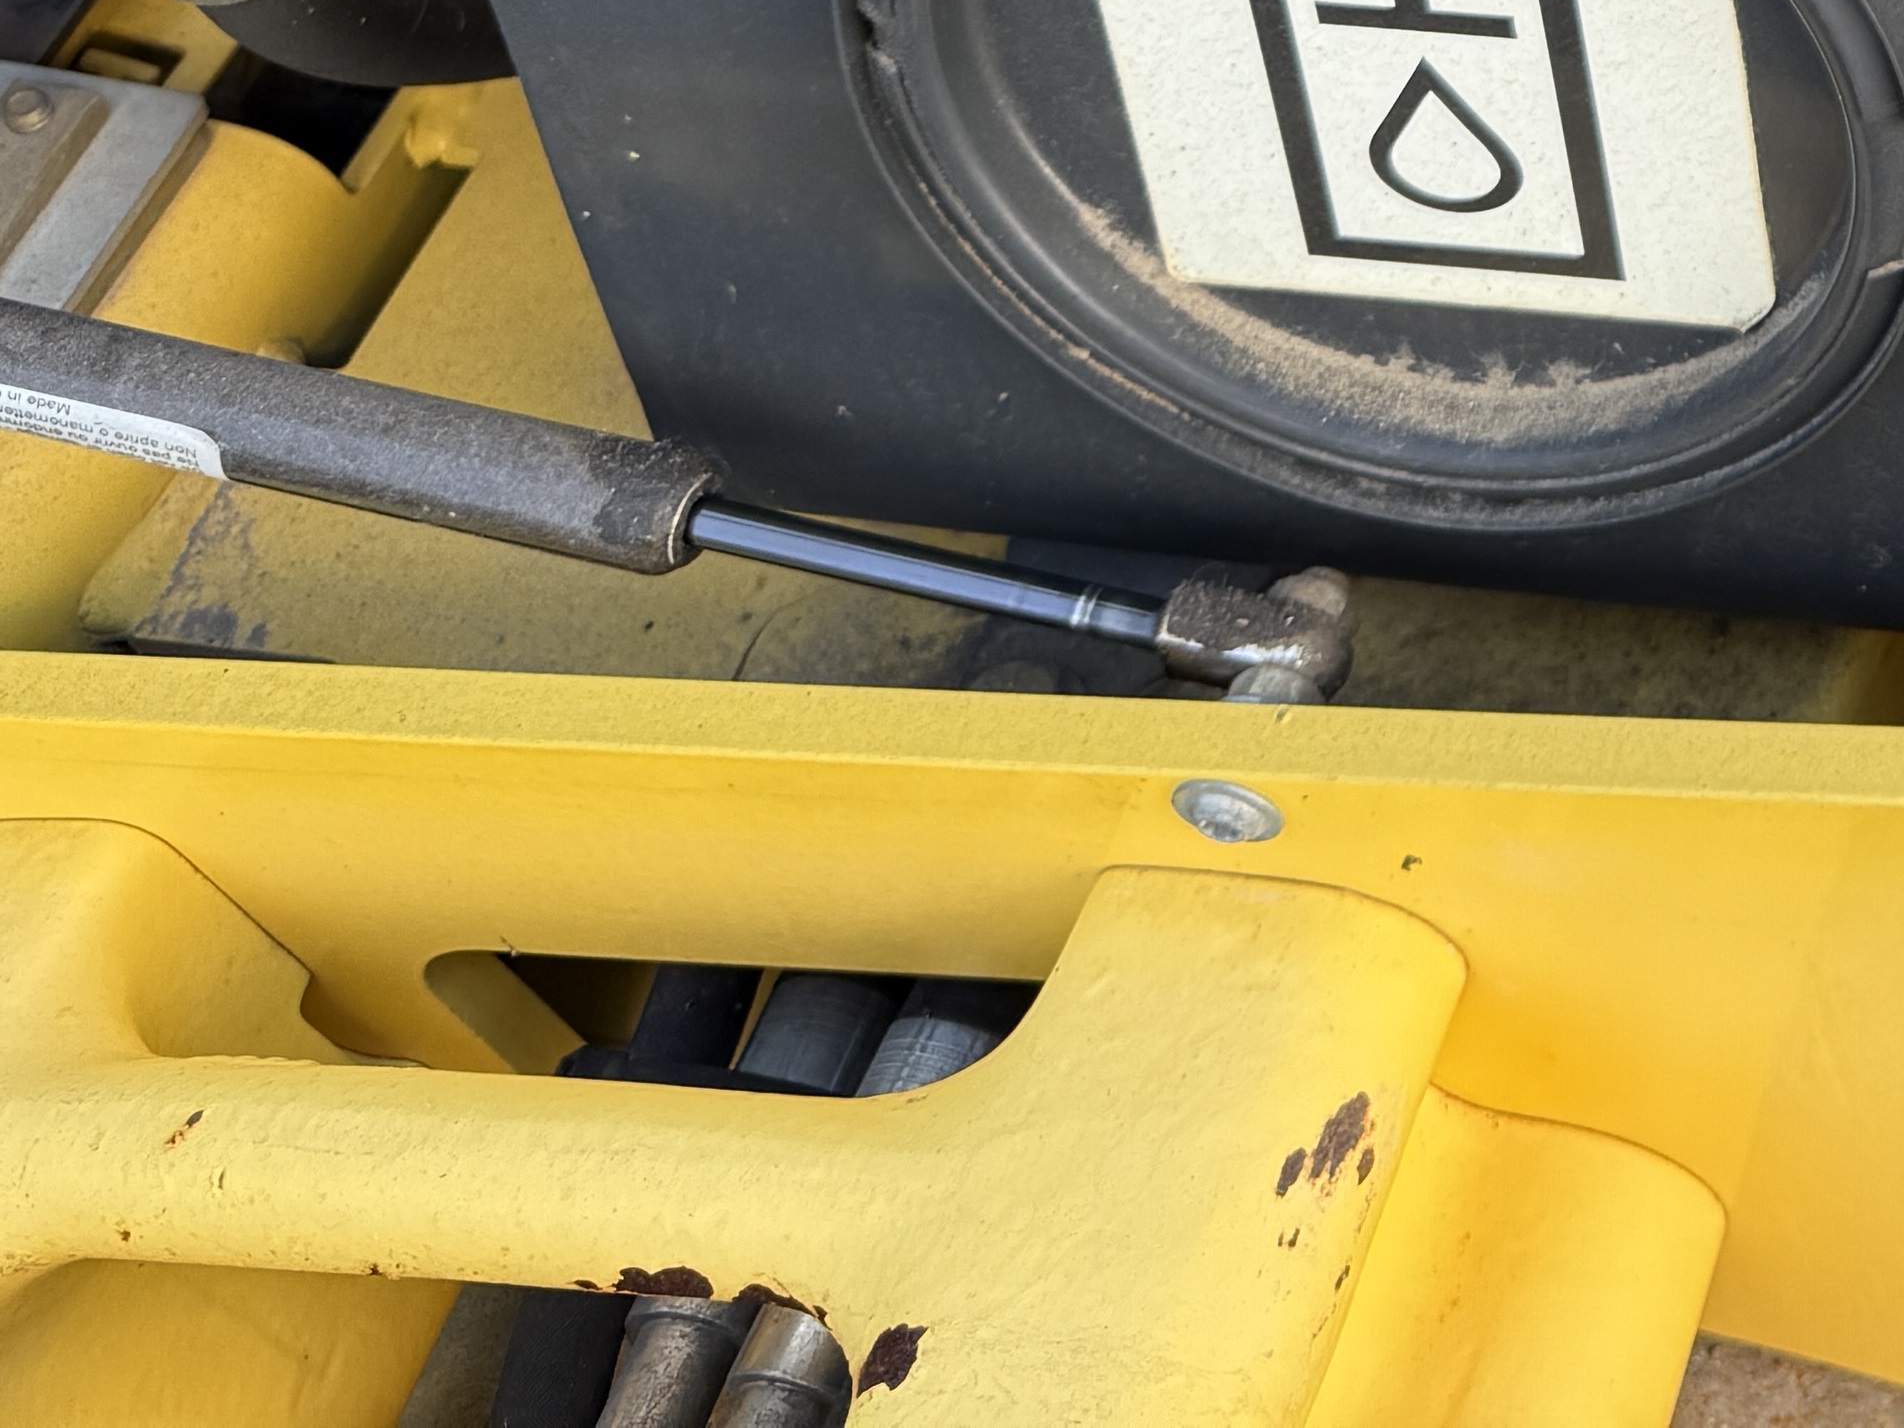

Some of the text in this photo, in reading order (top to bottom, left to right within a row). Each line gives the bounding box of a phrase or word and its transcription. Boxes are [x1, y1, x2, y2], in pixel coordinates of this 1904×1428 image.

[7, 390, 72, 417] Made in
[67, 429, 89, 443] ou
[98, 426, 110, 437] o
[113, 429, 161, 451] aprire
[142, 445, 172, 461] pas
[163, 441, 198, 459] Non
